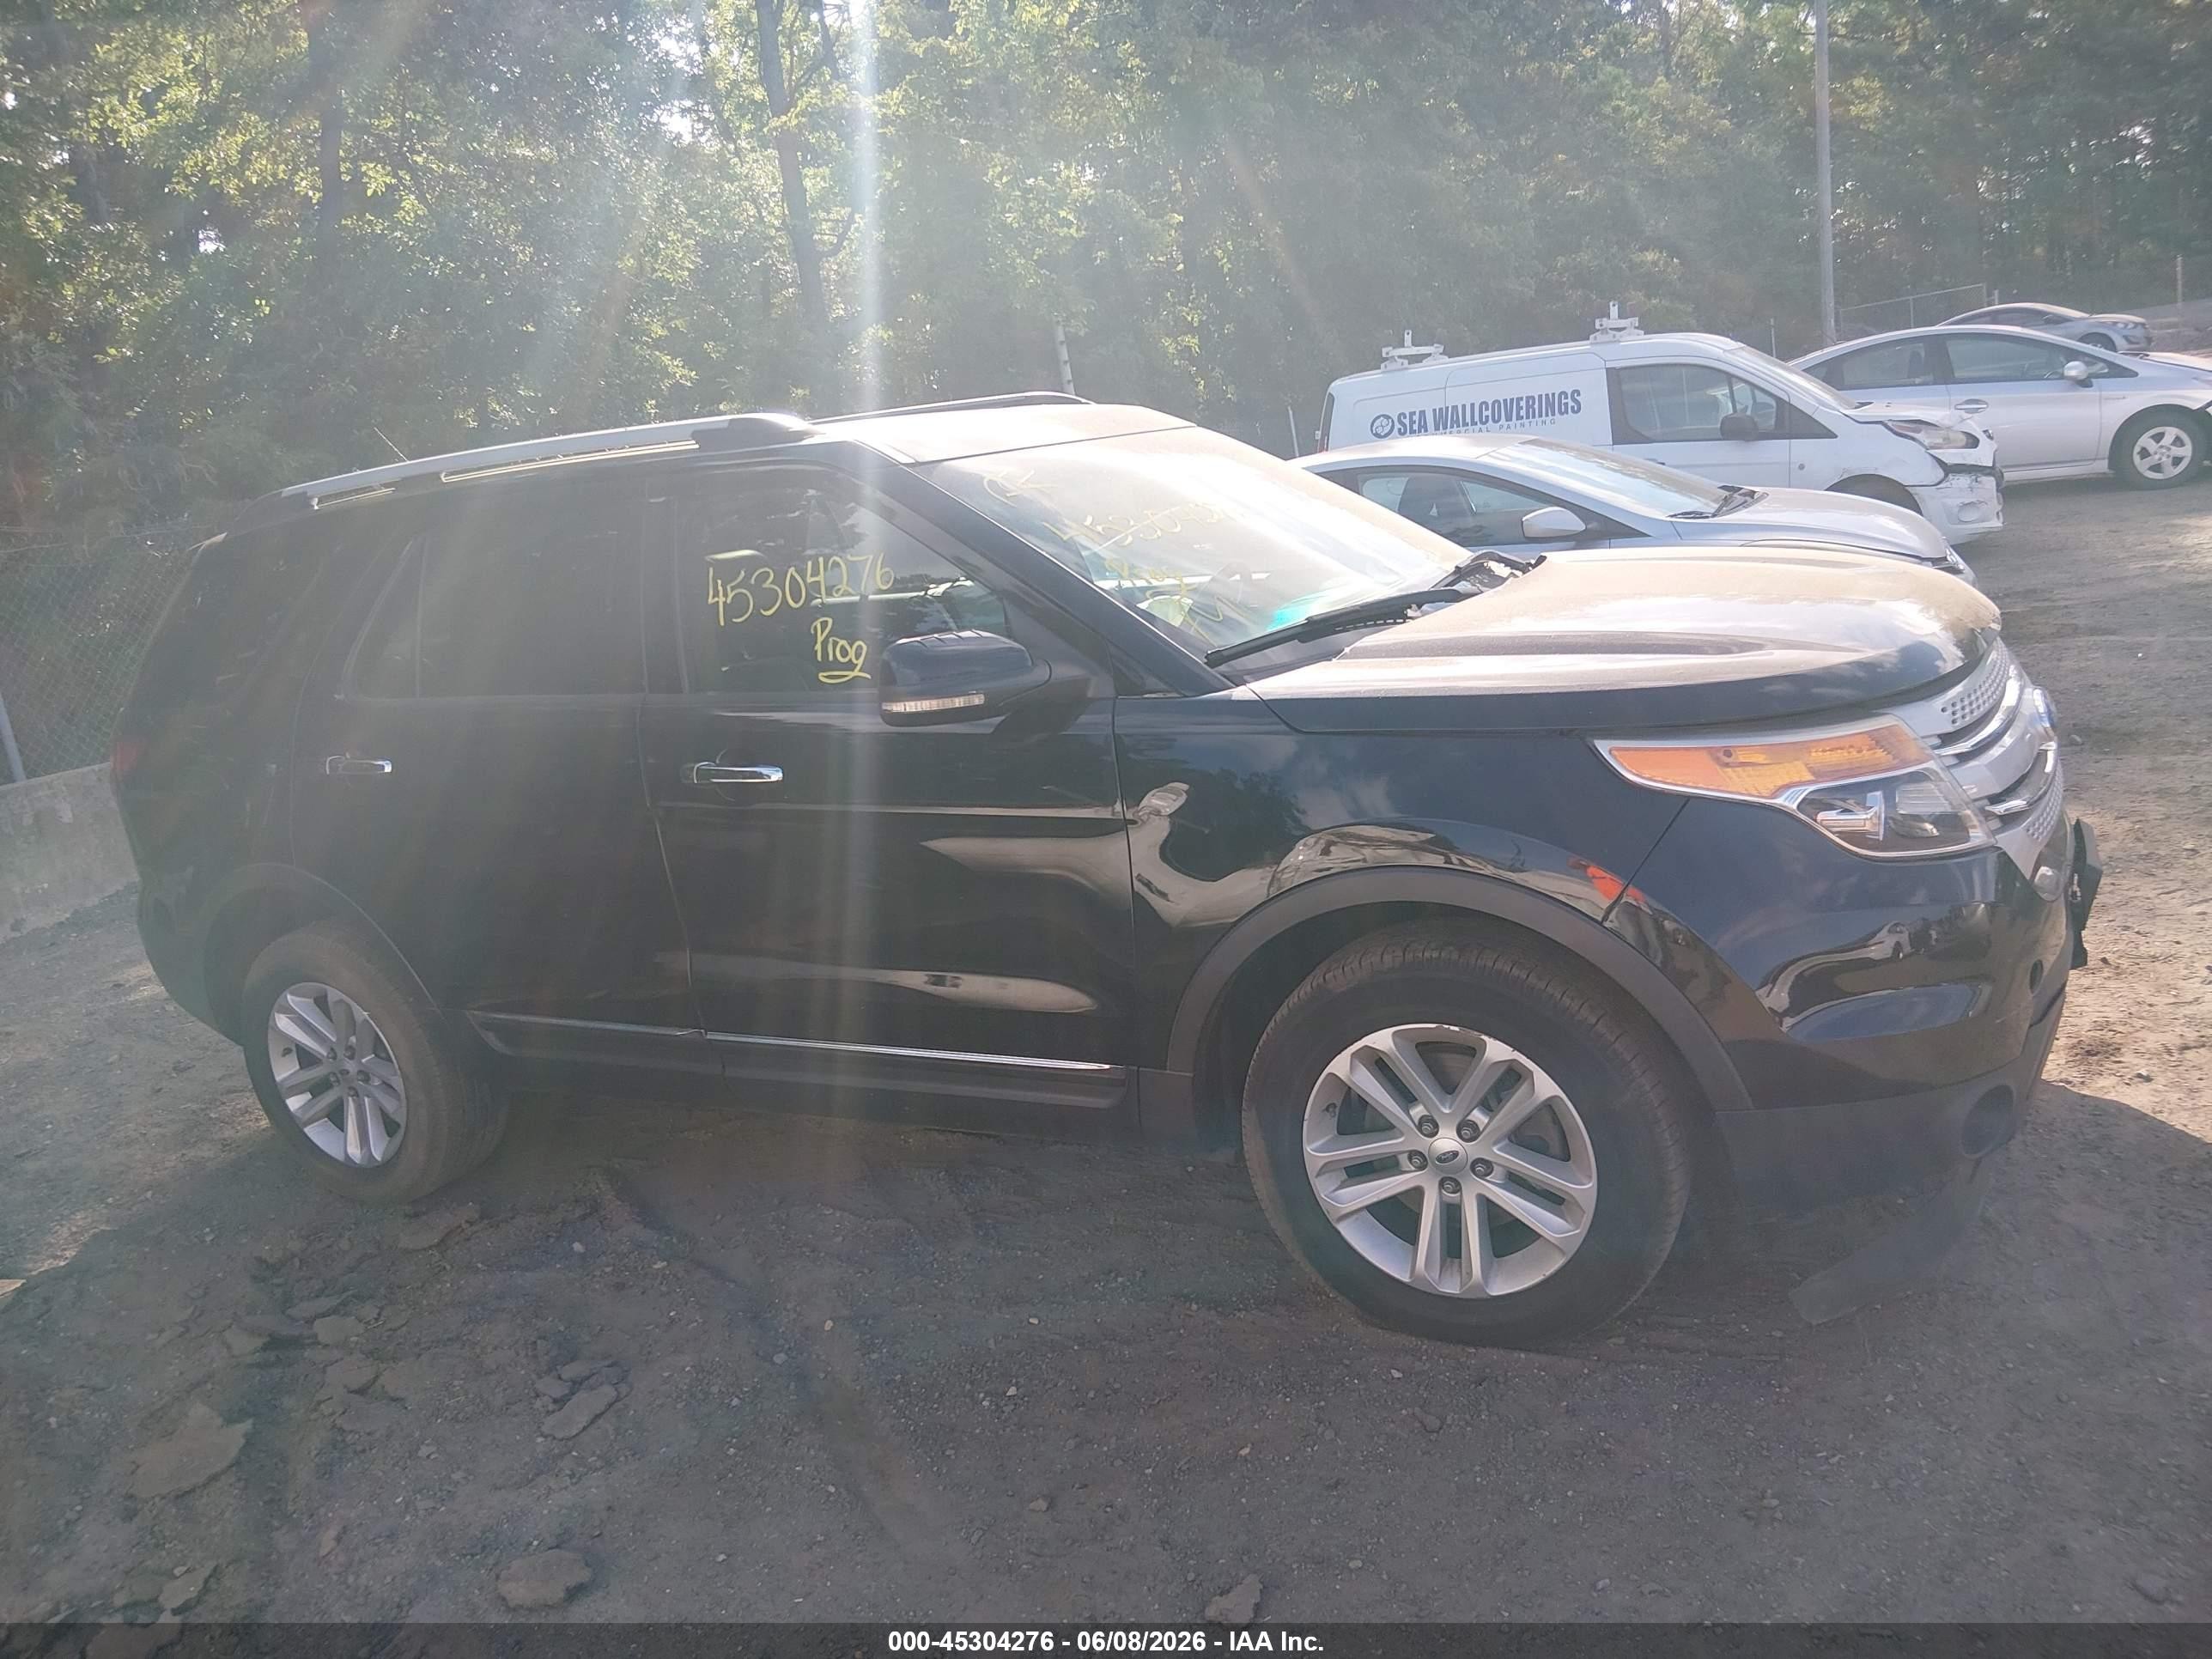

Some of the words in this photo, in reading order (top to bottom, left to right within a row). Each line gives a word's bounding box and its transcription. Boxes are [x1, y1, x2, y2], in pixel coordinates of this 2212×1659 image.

[1397, 409, 1429, 436] SEA
[1432, 389, 1582, 432] WALLCOVERINGS
[1498, 418, 1556, 431] PAINTING
[708, 553, 894, 626] 45304276
[811, 617, 872, 684] Prog
